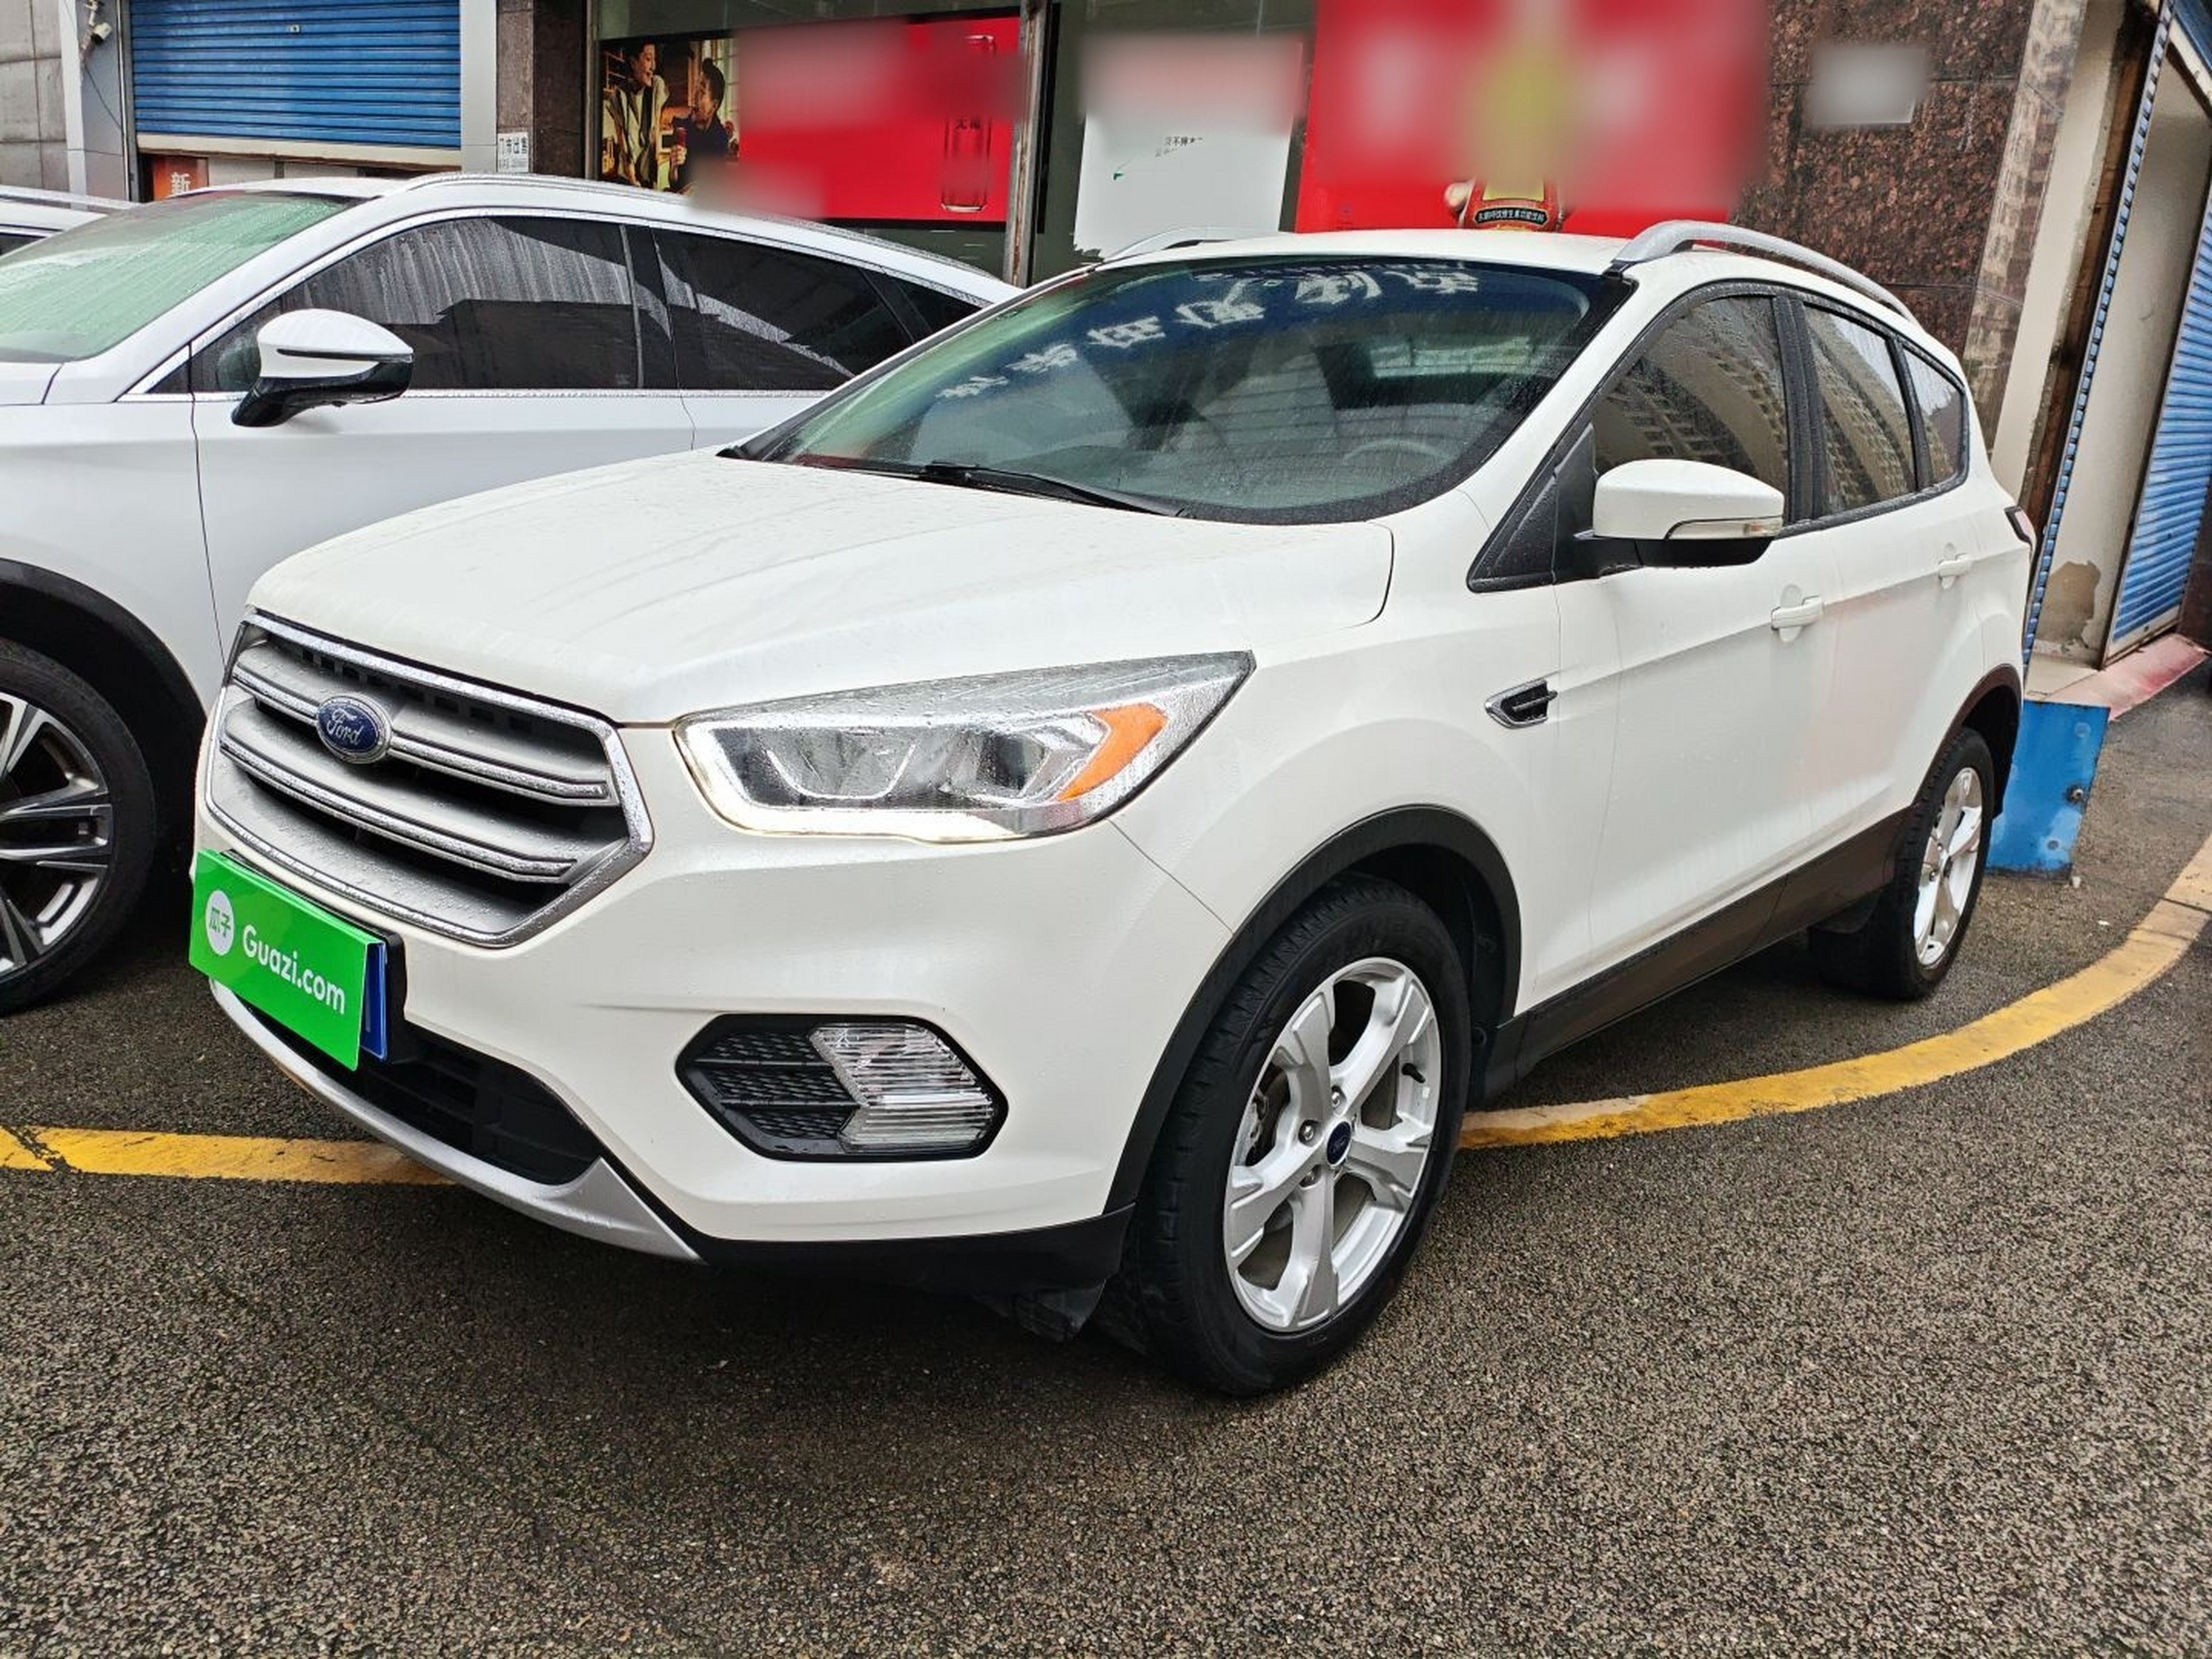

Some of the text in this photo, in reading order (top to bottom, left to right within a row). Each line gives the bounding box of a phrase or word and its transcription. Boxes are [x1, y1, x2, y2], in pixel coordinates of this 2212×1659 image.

[171, 171, 191, 195] 新
[325, 707, 365, 746] Ford
[209, 906, 232, 937] 瓜子
[242, 924, 346, 1016] Guazi.com
